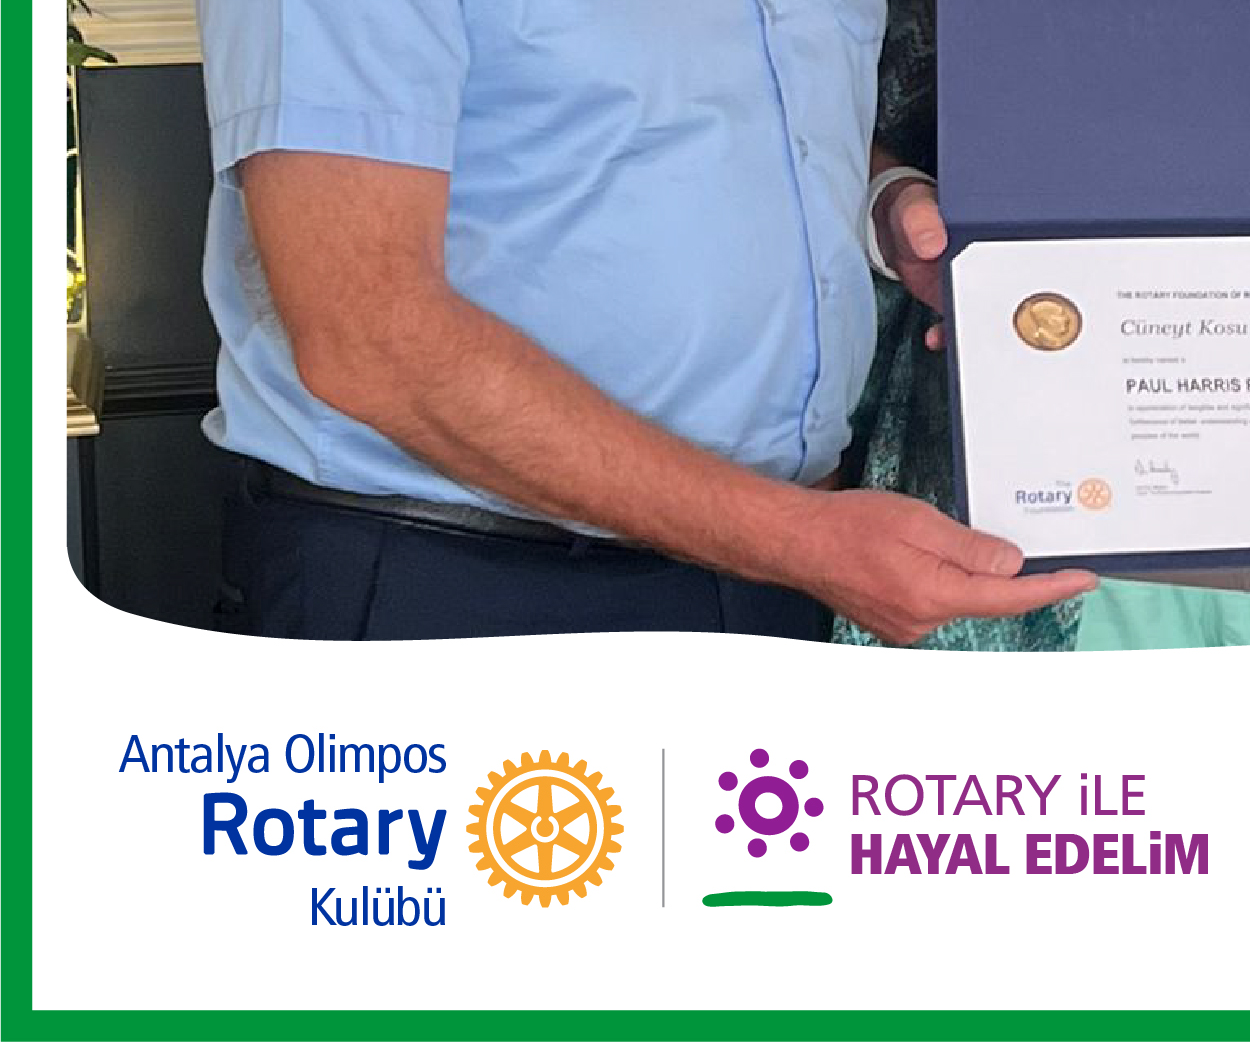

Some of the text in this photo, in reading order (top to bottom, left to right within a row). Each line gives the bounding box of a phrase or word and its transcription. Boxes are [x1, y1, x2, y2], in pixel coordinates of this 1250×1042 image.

[1126, 378, 1173, 394] PAUL
[1177, 377, 1241, 393] HARRIS
[1015, 490, 1072, 505] Rotary
